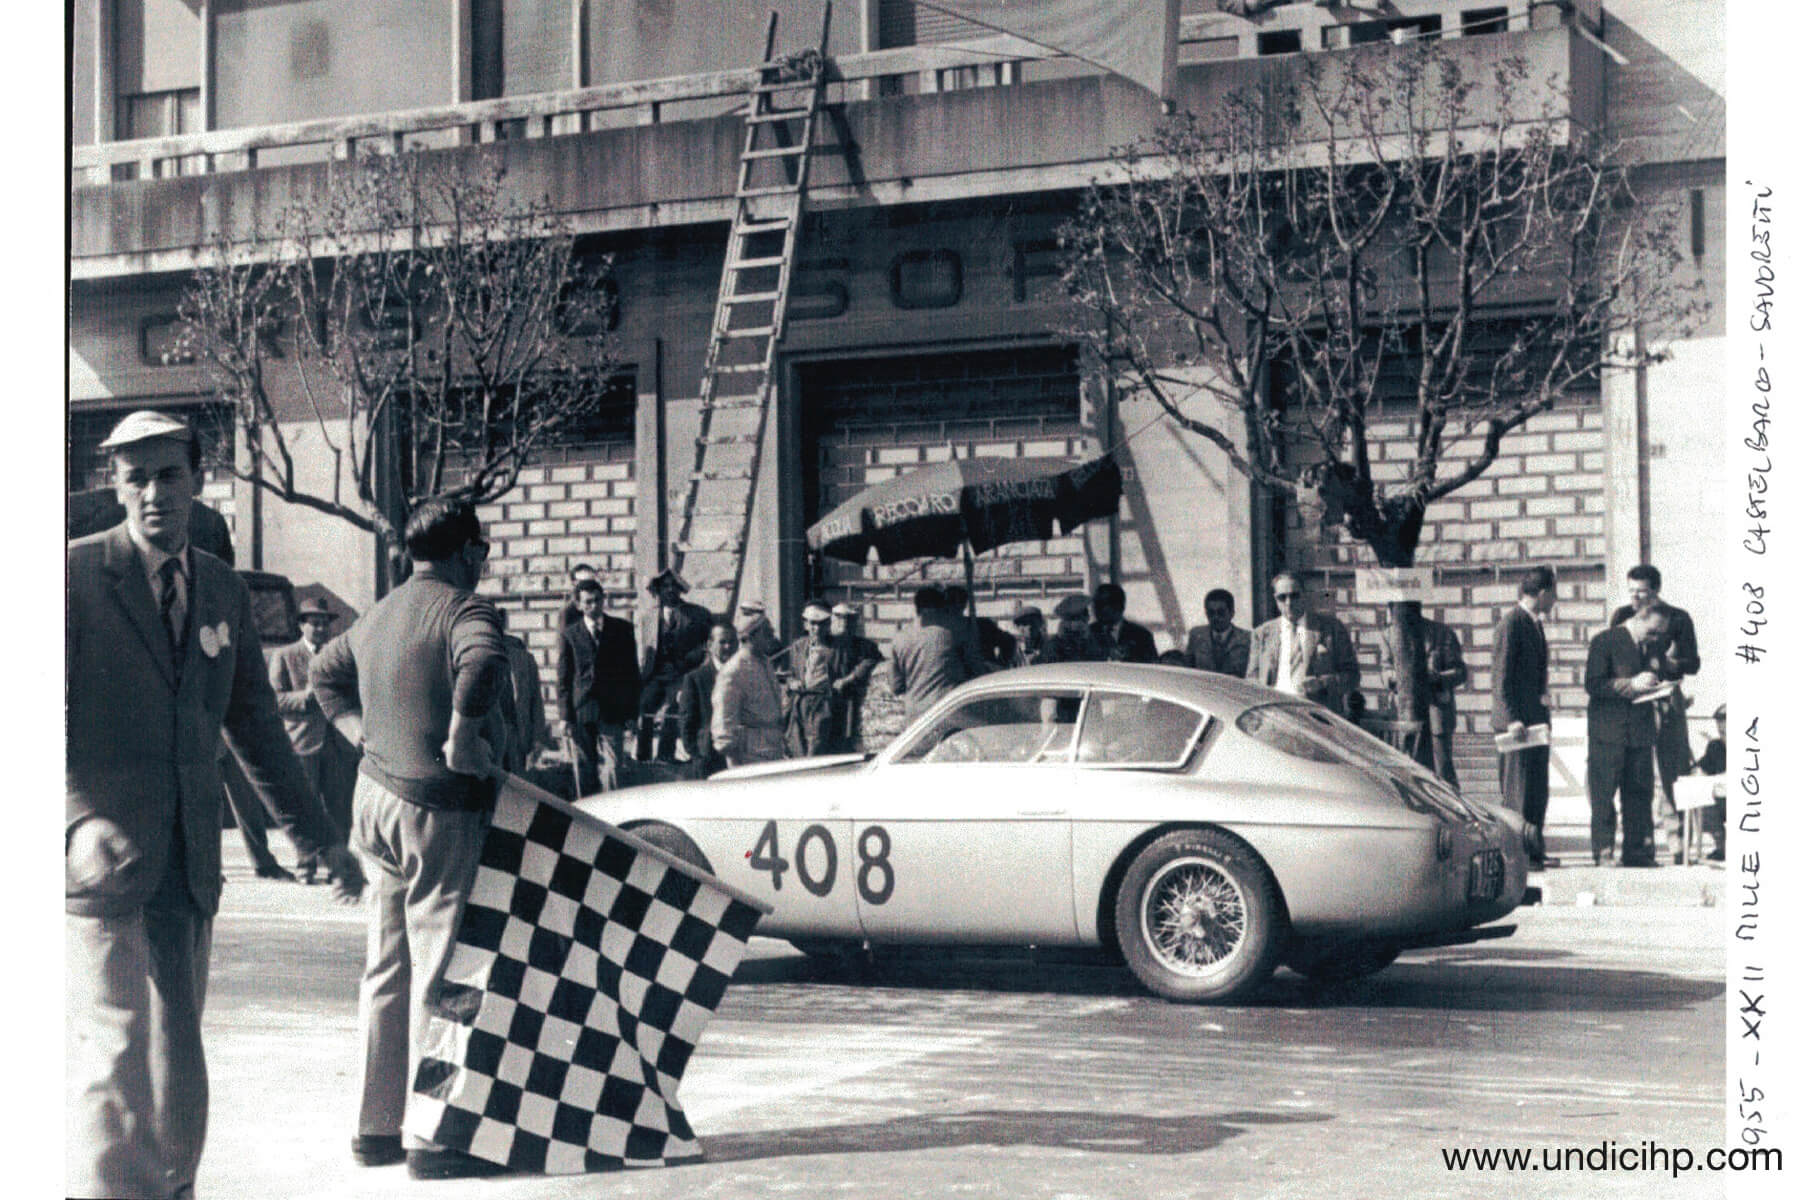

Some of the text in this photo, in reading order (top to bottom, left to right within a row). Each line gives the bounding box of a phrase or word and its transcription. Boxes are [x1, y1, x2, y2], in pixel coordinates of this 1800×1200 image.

[1740, 716, 1761, 832] MIGLIA
[750, 820, 895, 905] 408
[1736, 851, 1760, 940] MILLE
[1740, 966, 1766, 1040] XXII
